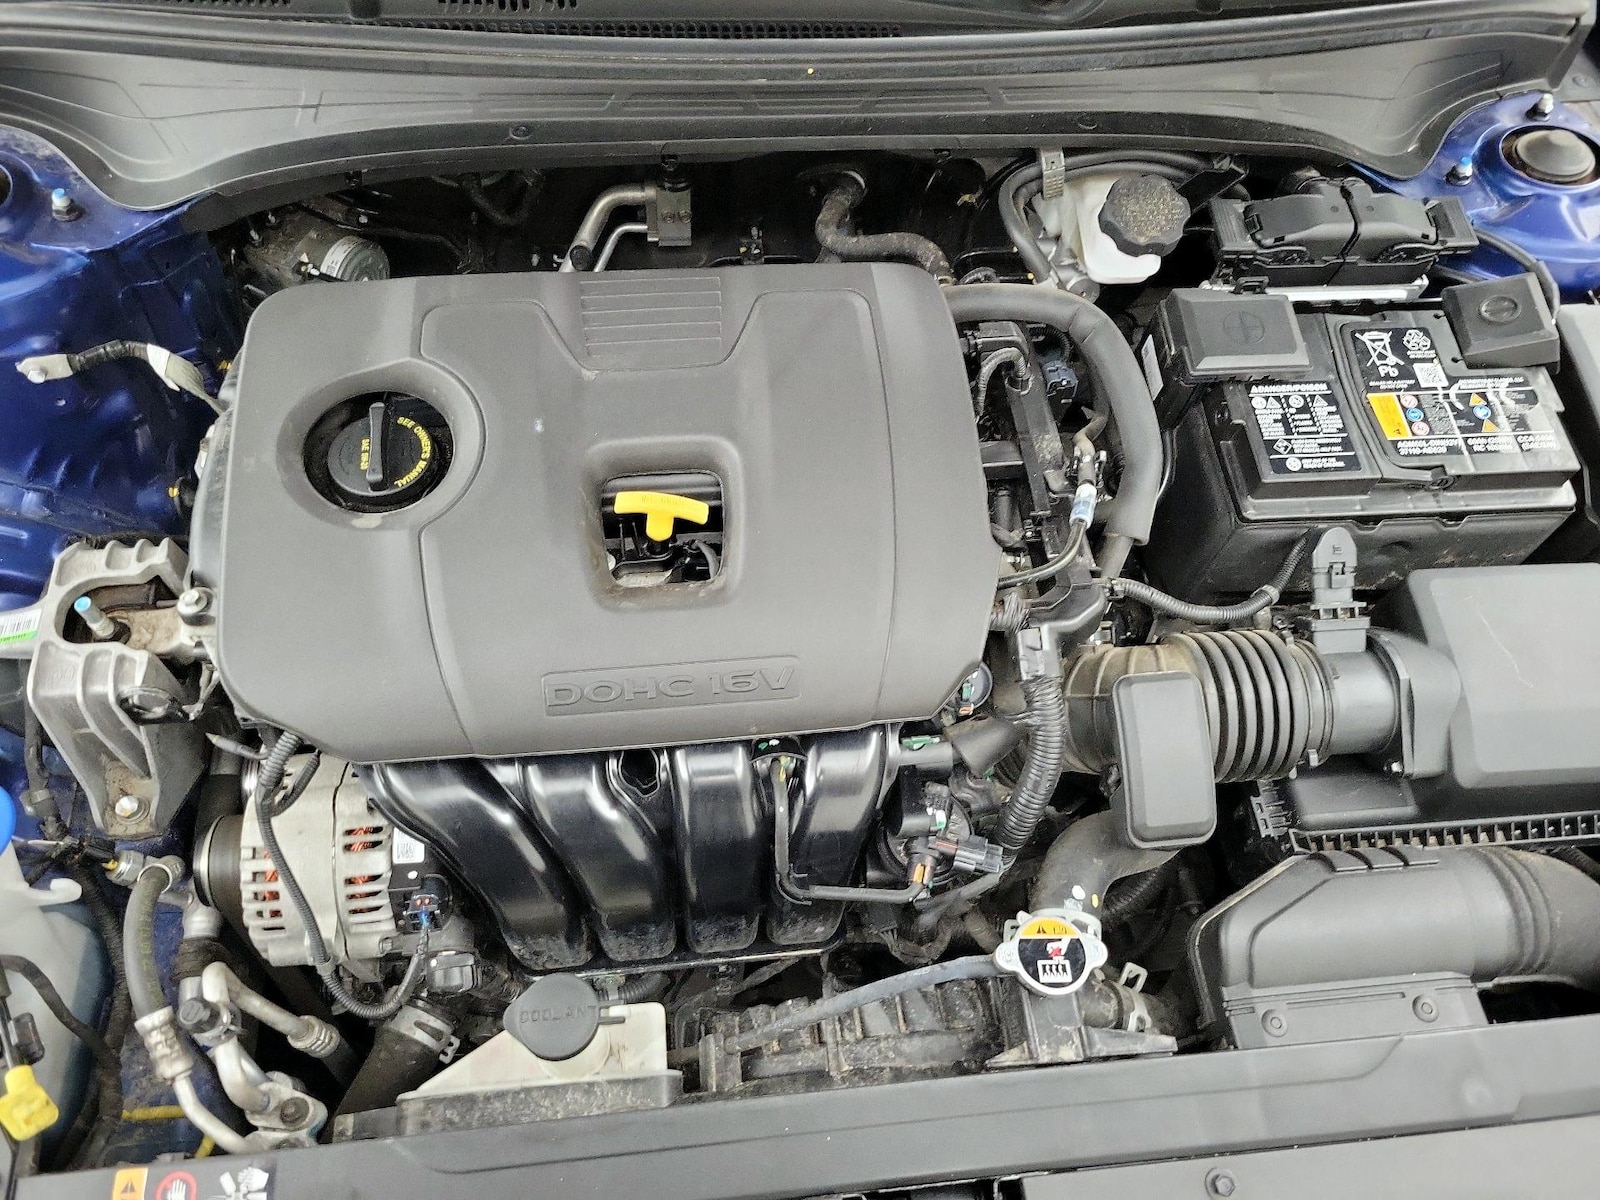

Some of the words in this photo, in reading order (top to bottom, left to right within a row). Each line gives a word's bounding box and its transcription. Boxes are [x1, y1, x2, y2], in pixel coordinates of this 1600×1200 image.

[1378, 365, 1399, 377] Pb
[397, 416, 415, 428] SEE
[414, 426, 430, 459] OWNER'S
[394, 460, 427, 487] MANUAL
[545, 674, 696, 707] DOHC
[708, 665, 795, 696] 16V
[520, 1005, 597, 1023] COOLANT
